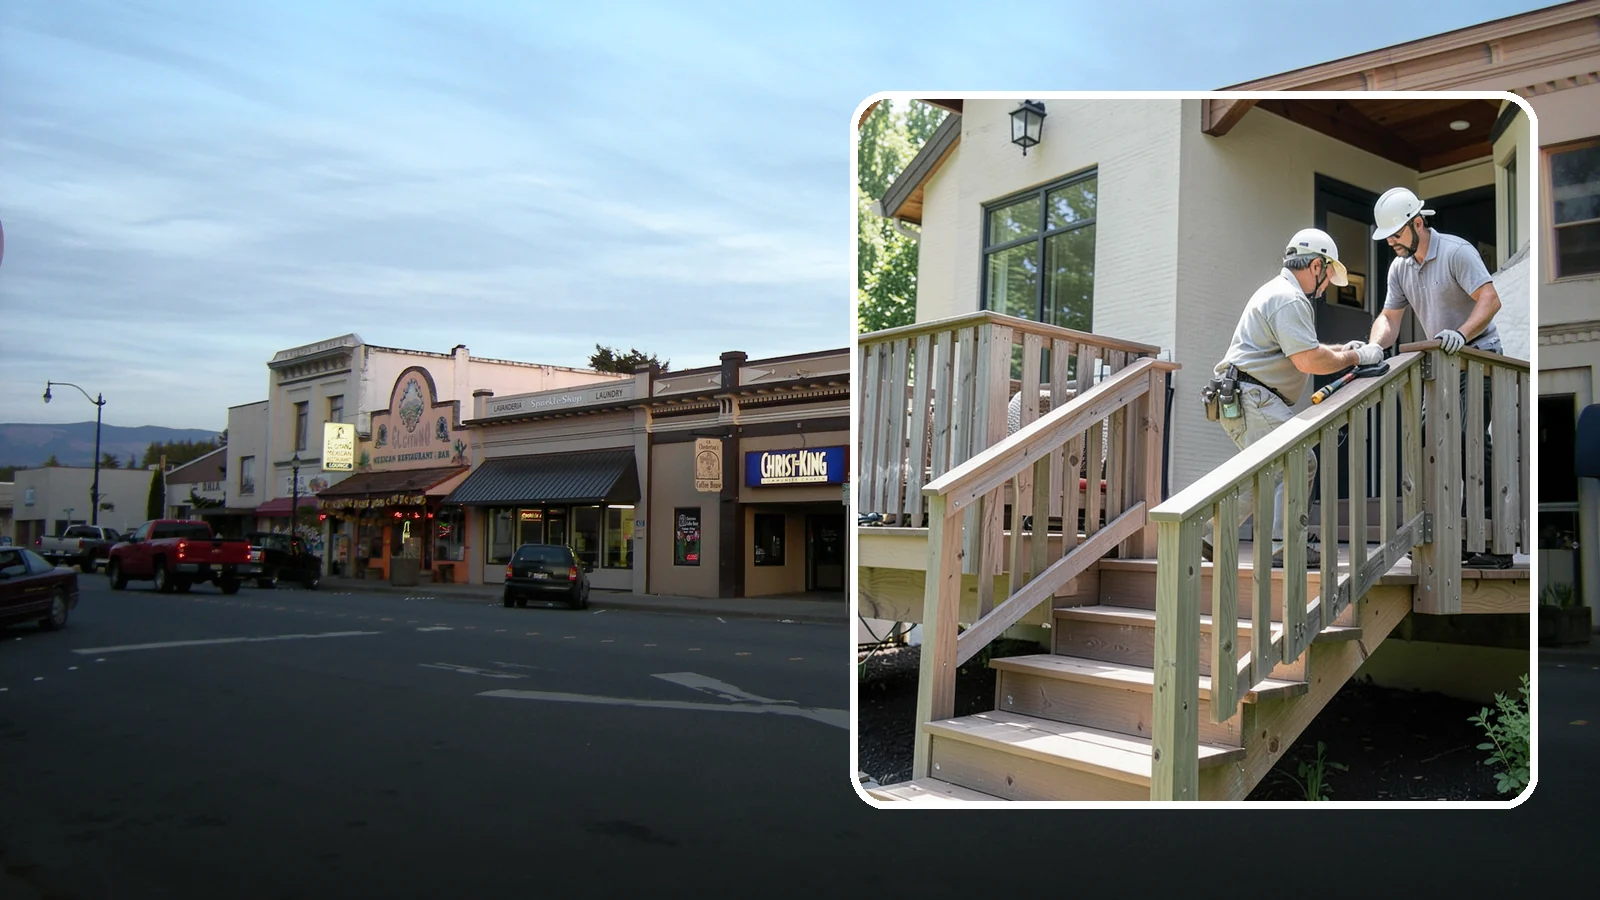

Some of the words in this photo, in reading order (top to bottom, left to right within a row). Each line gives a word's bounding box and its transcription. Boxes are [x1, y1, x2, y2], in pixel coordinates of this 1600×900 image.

[493, 402, 523, 412] LAVANDERIA
[531, 397, 561, 409] Sparkle
[561, 394, 583, 405] Shop
[595, 389, 623, 400] LAUNDRY
[373, 454, 397, 464] MEXICAN
[397, 451, 434, 462] RESTAURANT
[437, 450, 450, 459] BAR
